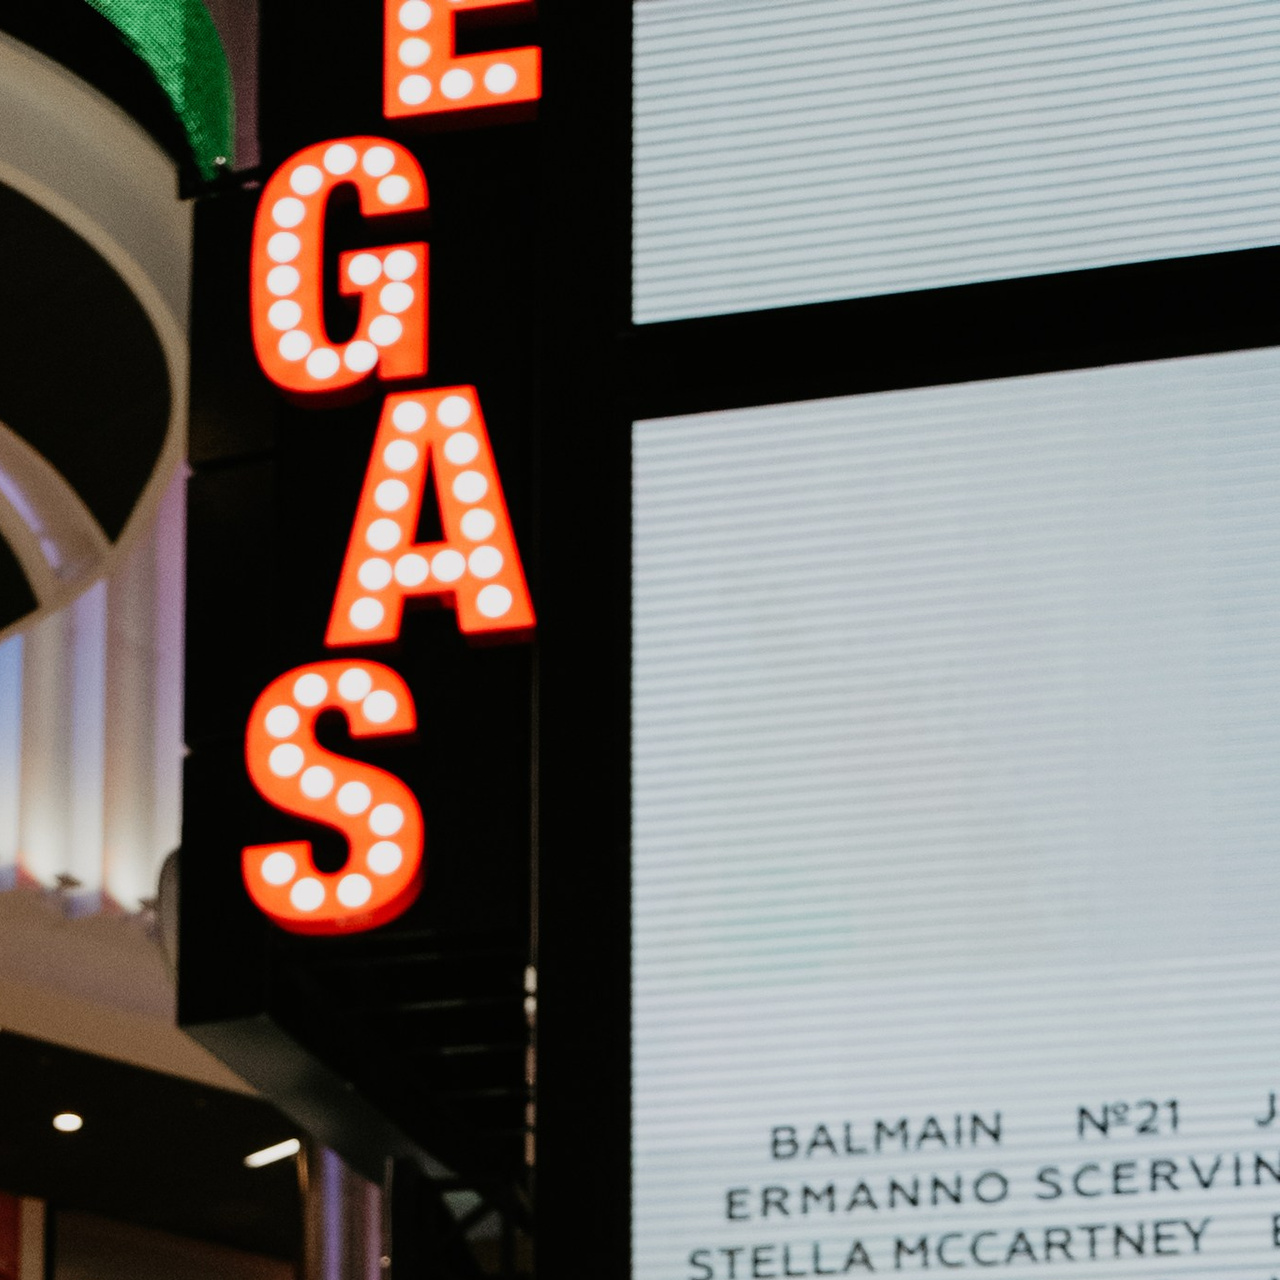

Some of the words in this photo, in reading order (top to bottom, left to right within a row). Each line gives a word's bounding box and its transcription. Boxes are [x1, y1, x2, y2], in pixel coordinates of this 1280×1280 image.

[770, 1112, 1003, 1160] BALMAIN
[724, 1170, 1010, 1221] ERMANNO
[893, 1217, 1212, 1271] MCCARTNEY
